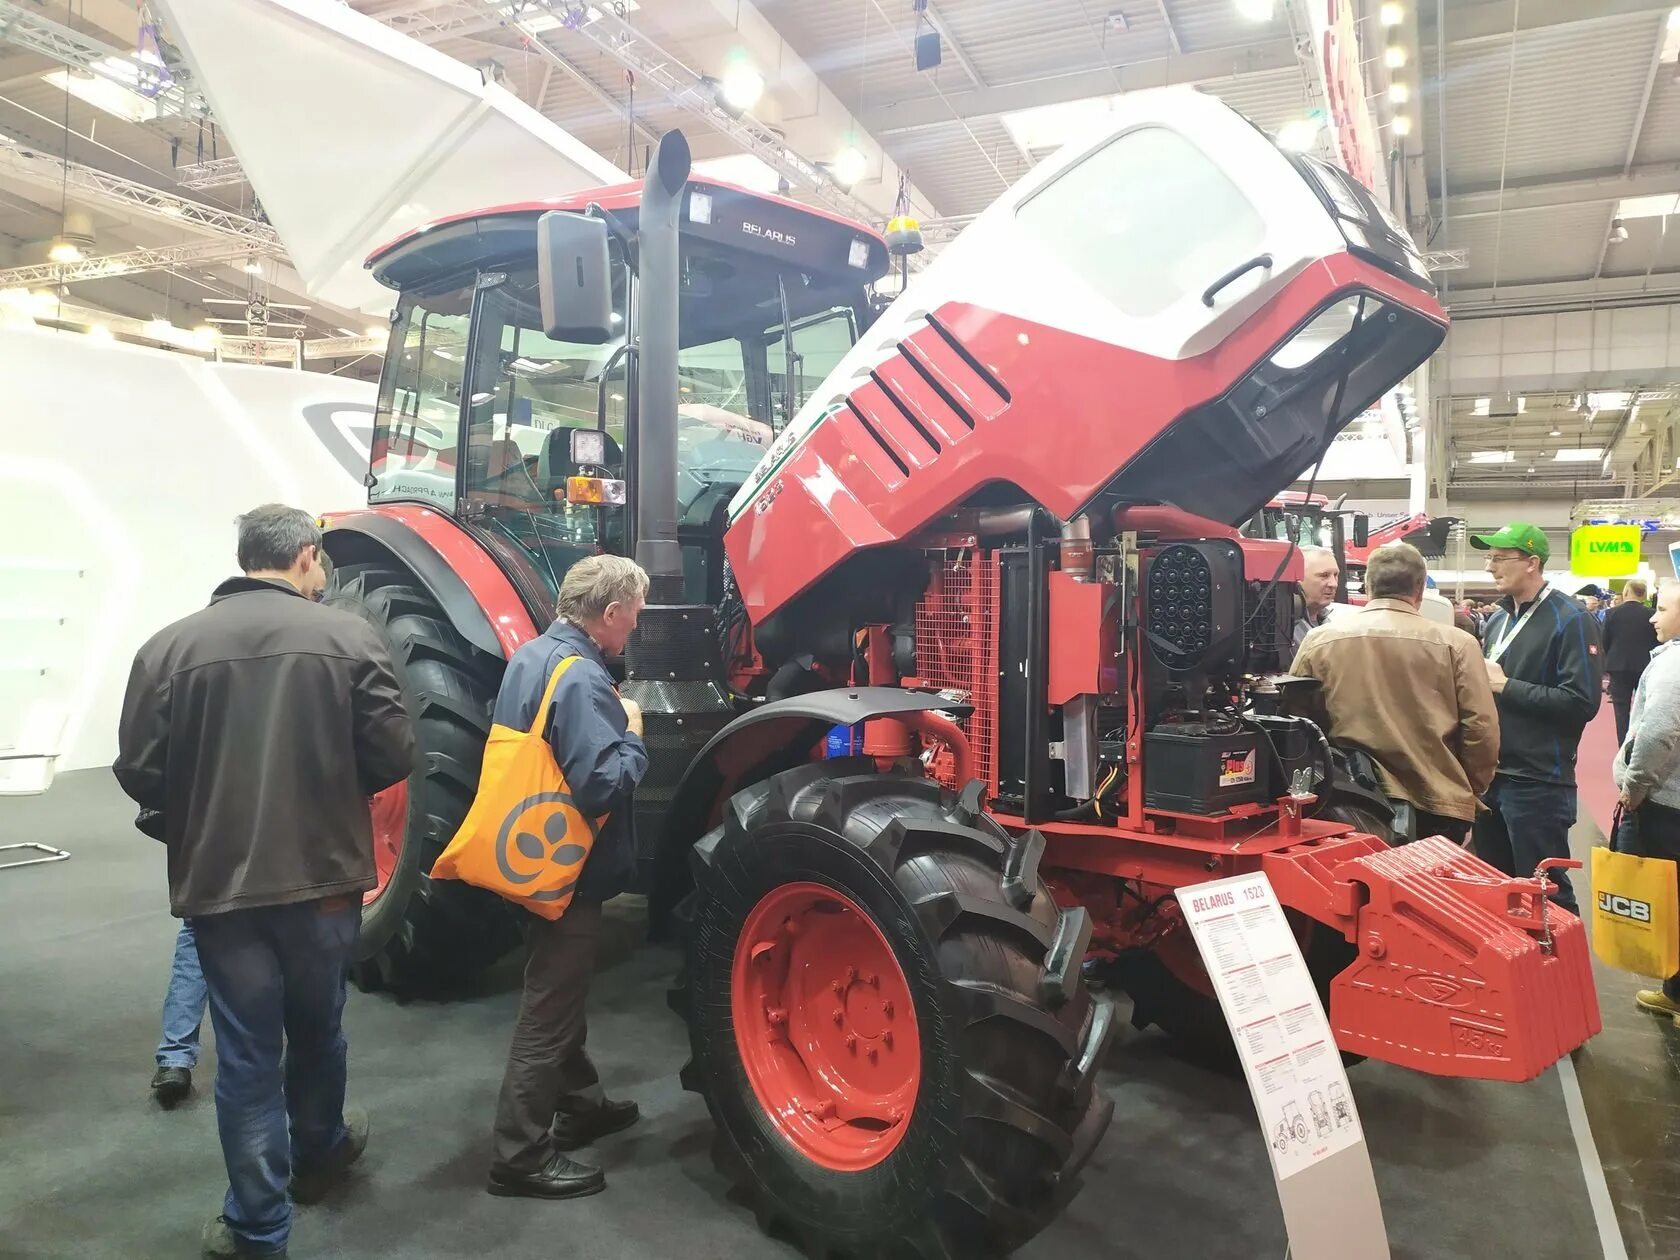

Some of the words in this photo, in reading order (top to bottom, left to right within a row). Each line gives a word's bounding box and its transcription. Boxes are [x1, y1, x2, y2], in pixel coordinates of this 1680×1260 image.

[742, 222, 796, 247] BELARUS
[1589, 541, 1619, 553] LVM
[1192, 891, 1235, 913] BELARUS
[1243, 885, 1265, 901] 1523
[1599, 892, 1650, 921] JCB
